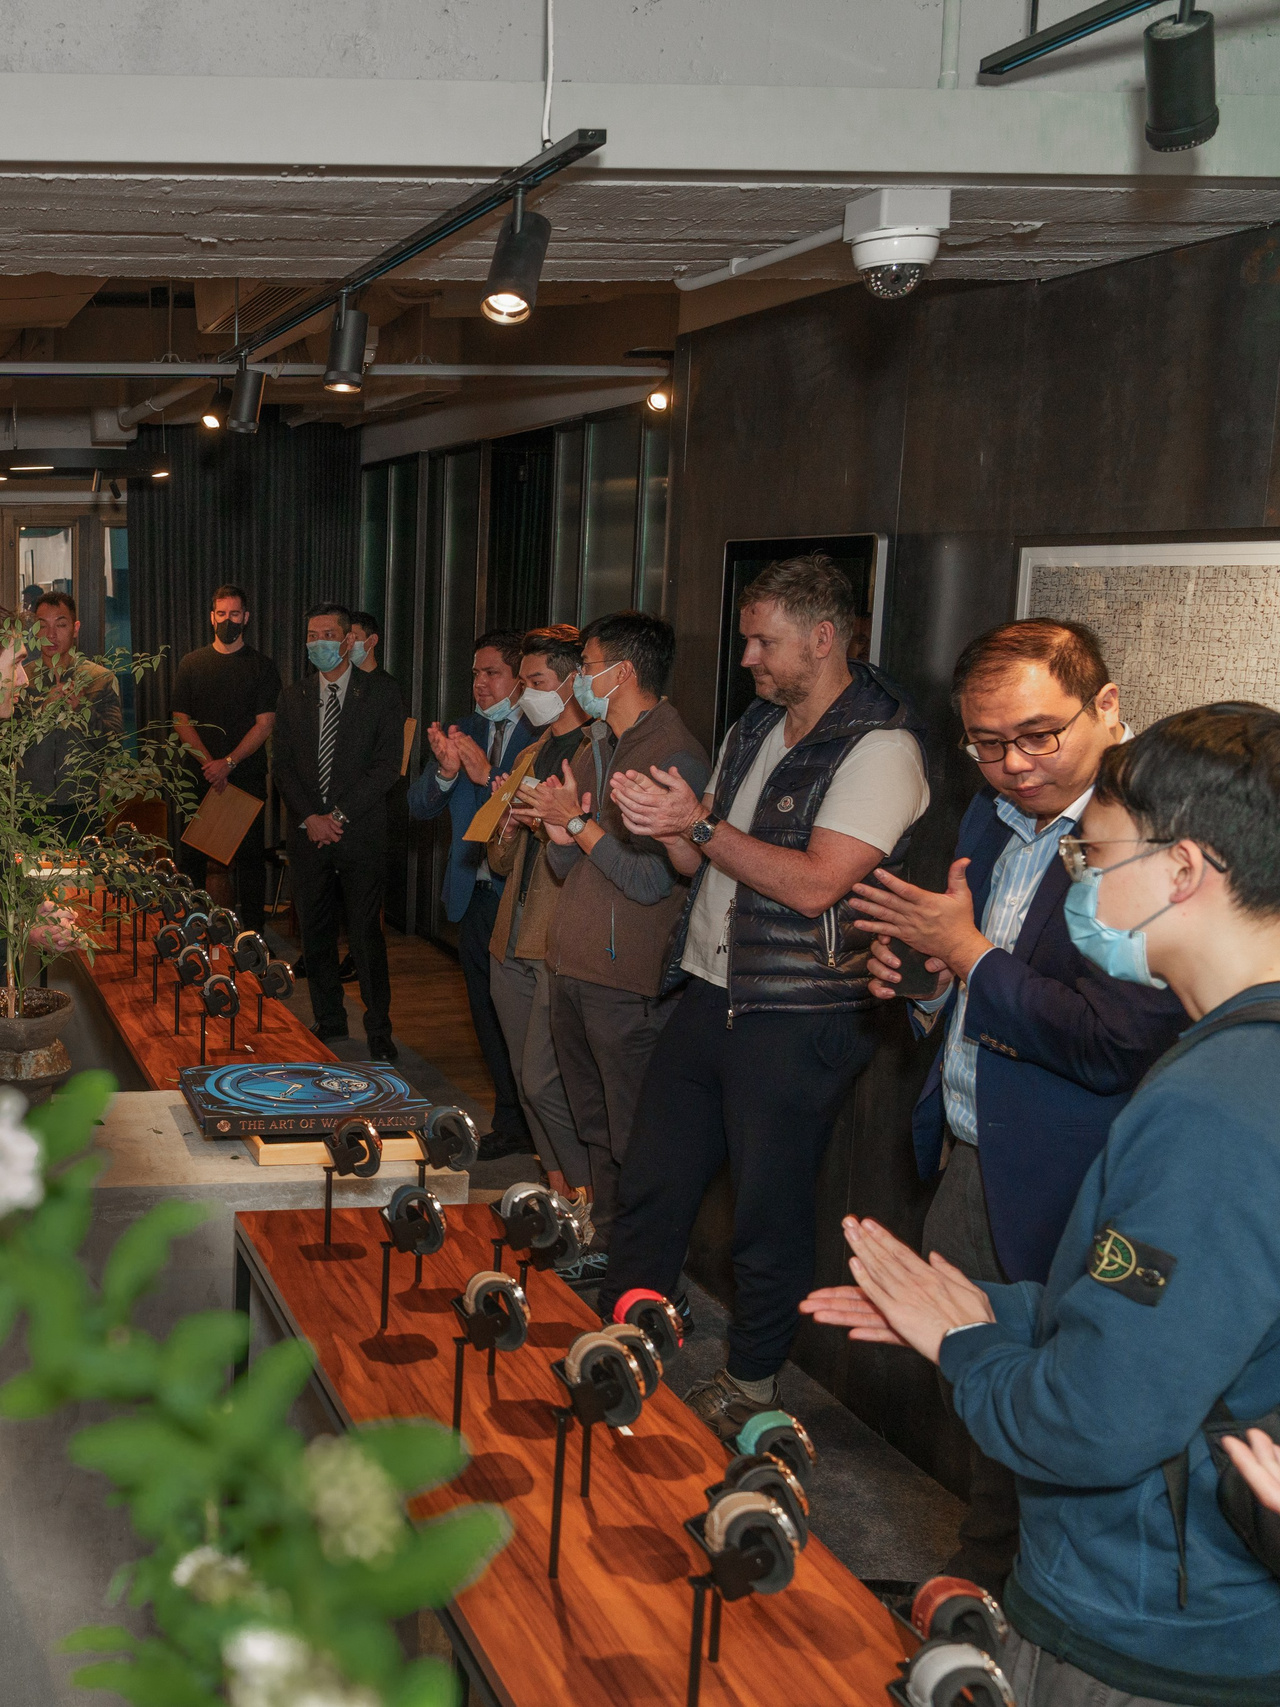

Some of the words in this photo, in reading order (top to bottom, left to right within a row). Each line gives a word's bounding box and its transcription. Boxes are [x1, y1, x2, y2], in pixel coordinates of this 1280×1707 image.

[239, 1119, 265, 1131] THE
[269, 1118, 296, 1130] ART
[299, 1117, 317, 1129] OF
[320, 1114, 417, 1129] WAMAKING
